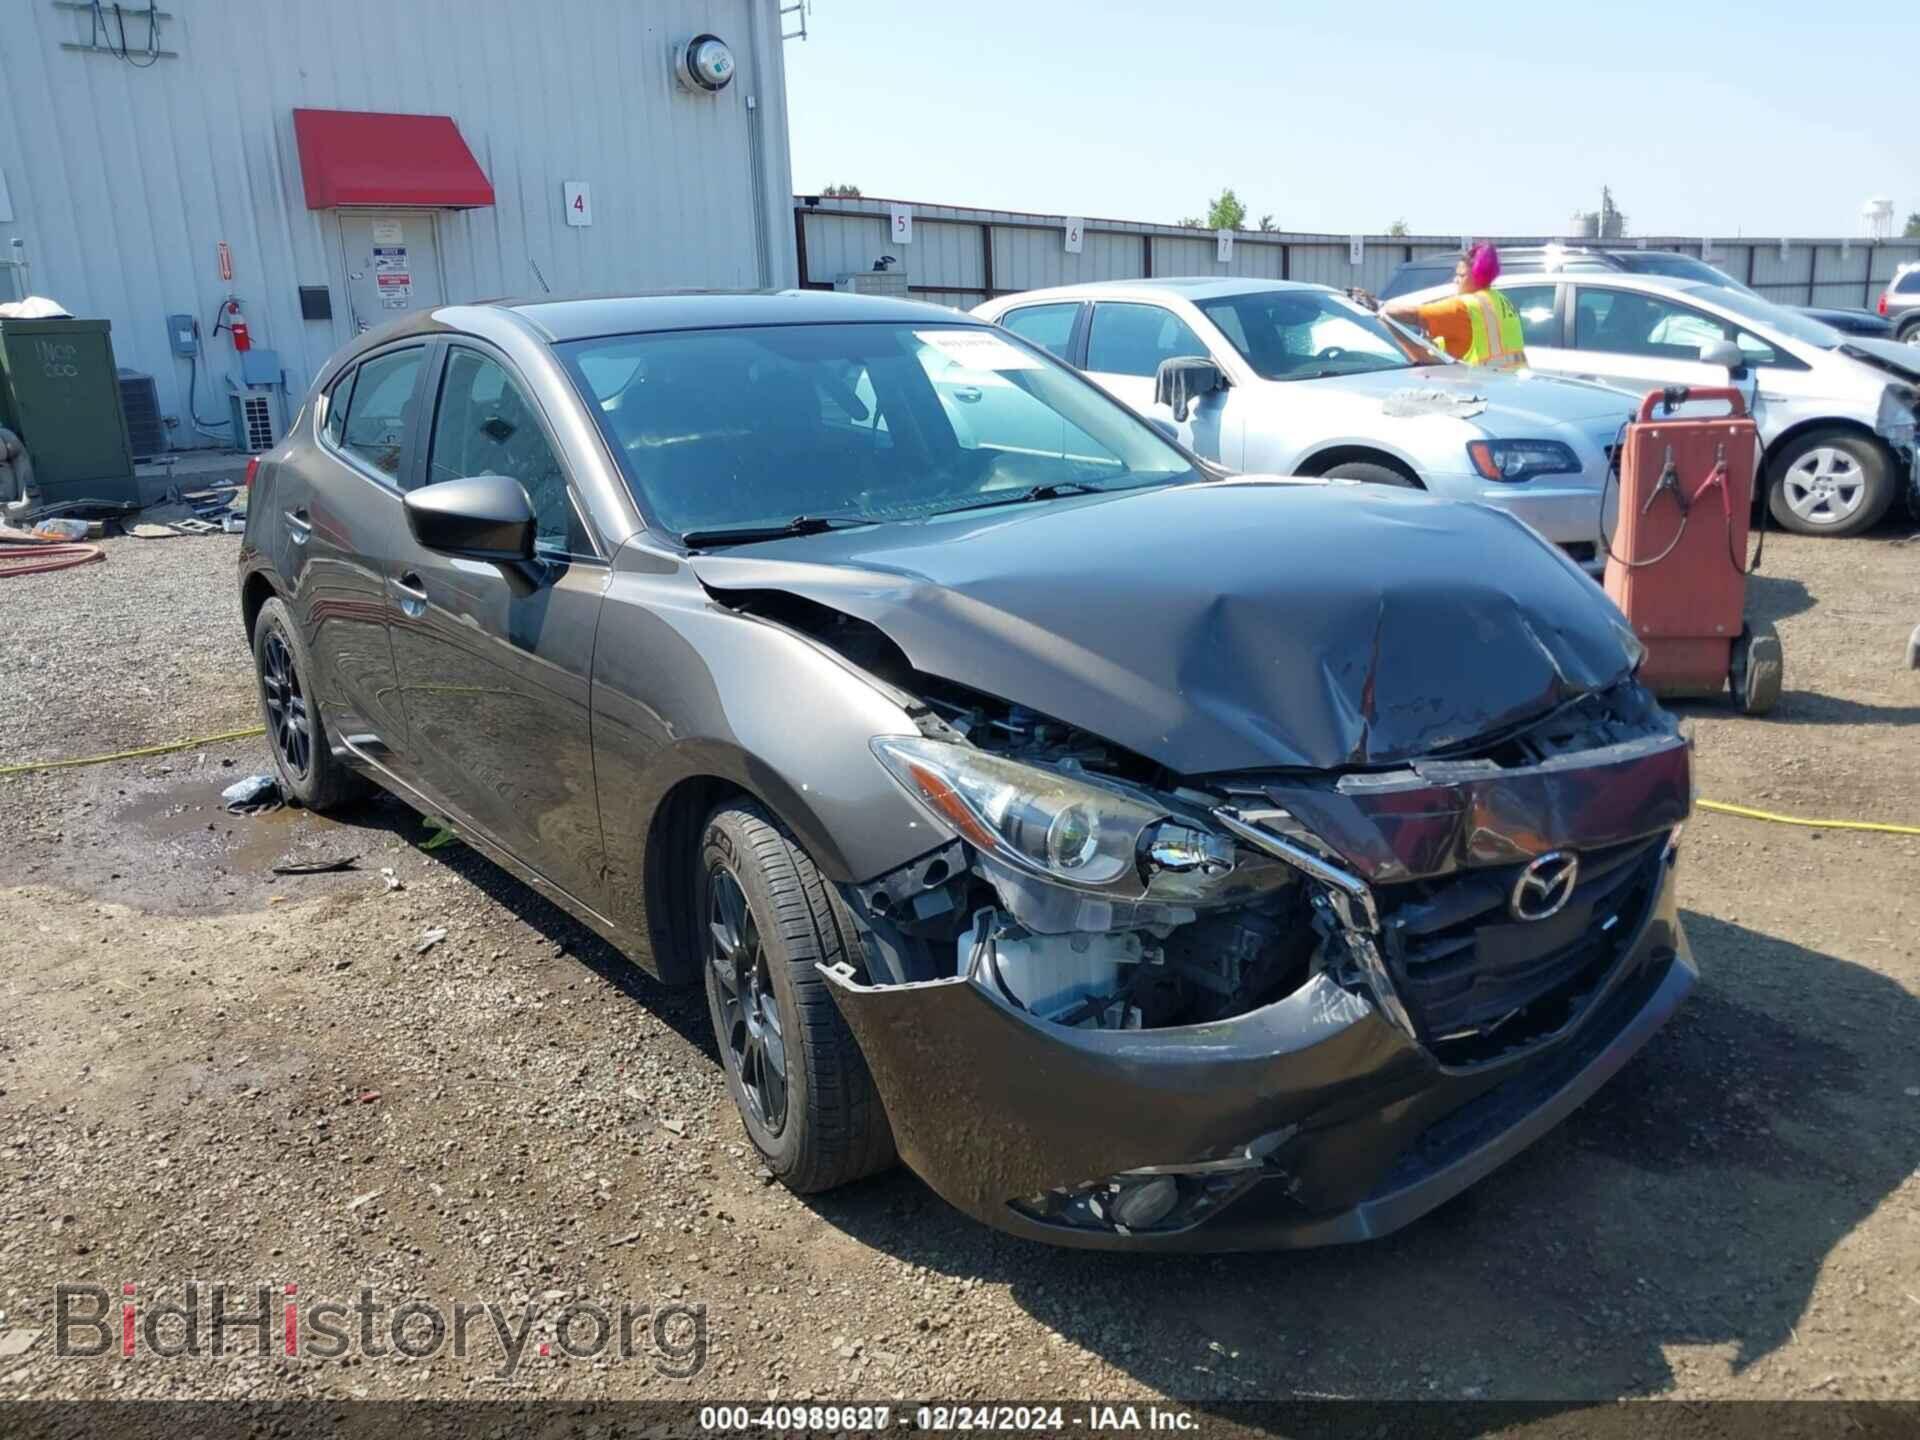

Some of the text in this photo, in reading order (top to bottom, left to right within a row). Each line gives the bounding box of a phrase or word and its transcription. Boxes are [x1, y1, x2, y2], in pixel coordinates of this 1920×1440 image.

[574, 194, 584, 213] 4
[897, 215, 906, 232] 5
[1070, 227, 1078, 242] 6
